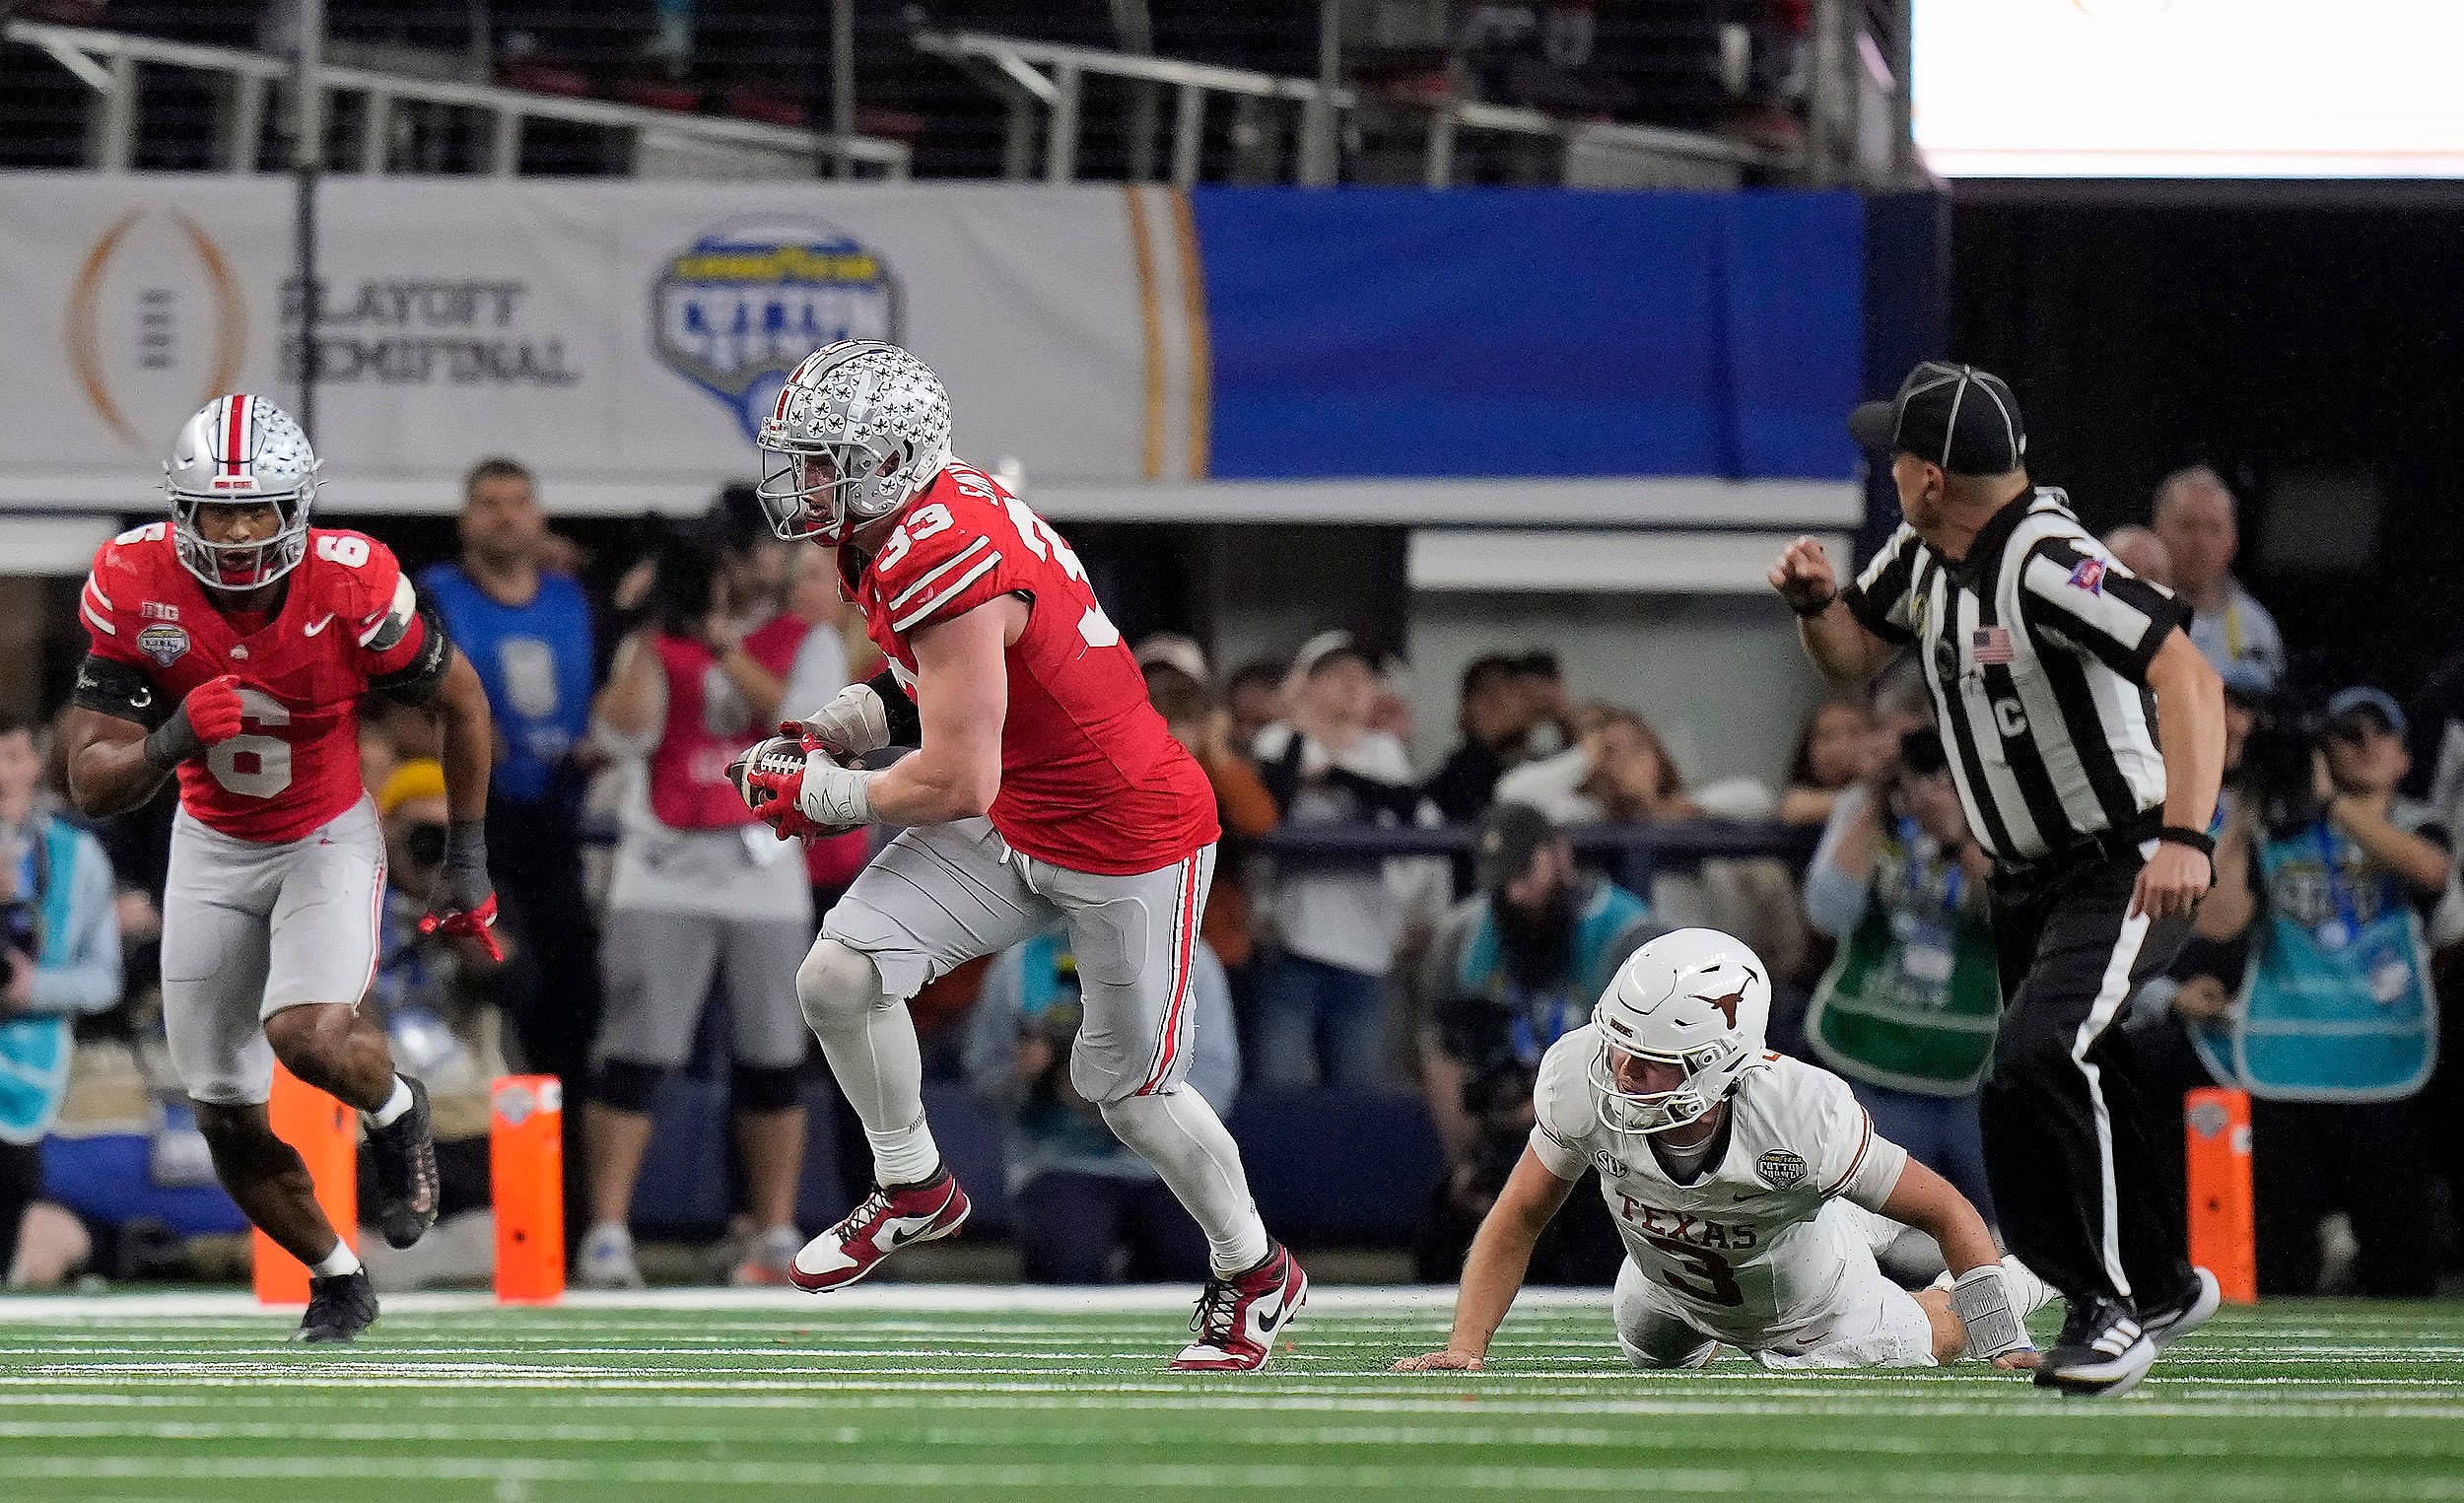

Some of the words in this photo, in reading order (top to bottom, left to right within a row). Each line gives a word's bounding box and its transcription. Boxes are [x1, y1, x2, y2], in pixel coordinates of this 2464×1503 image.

[317, 535, 371, 569] 6
[876, 503, 955, 573] 33
[206, 689, 293, 798] 6
[1993, 696, 2028, 737] C
[1614, 1188, 1757, 1250] TEXAS
[1646, 1236, 1745, 1308] 3
